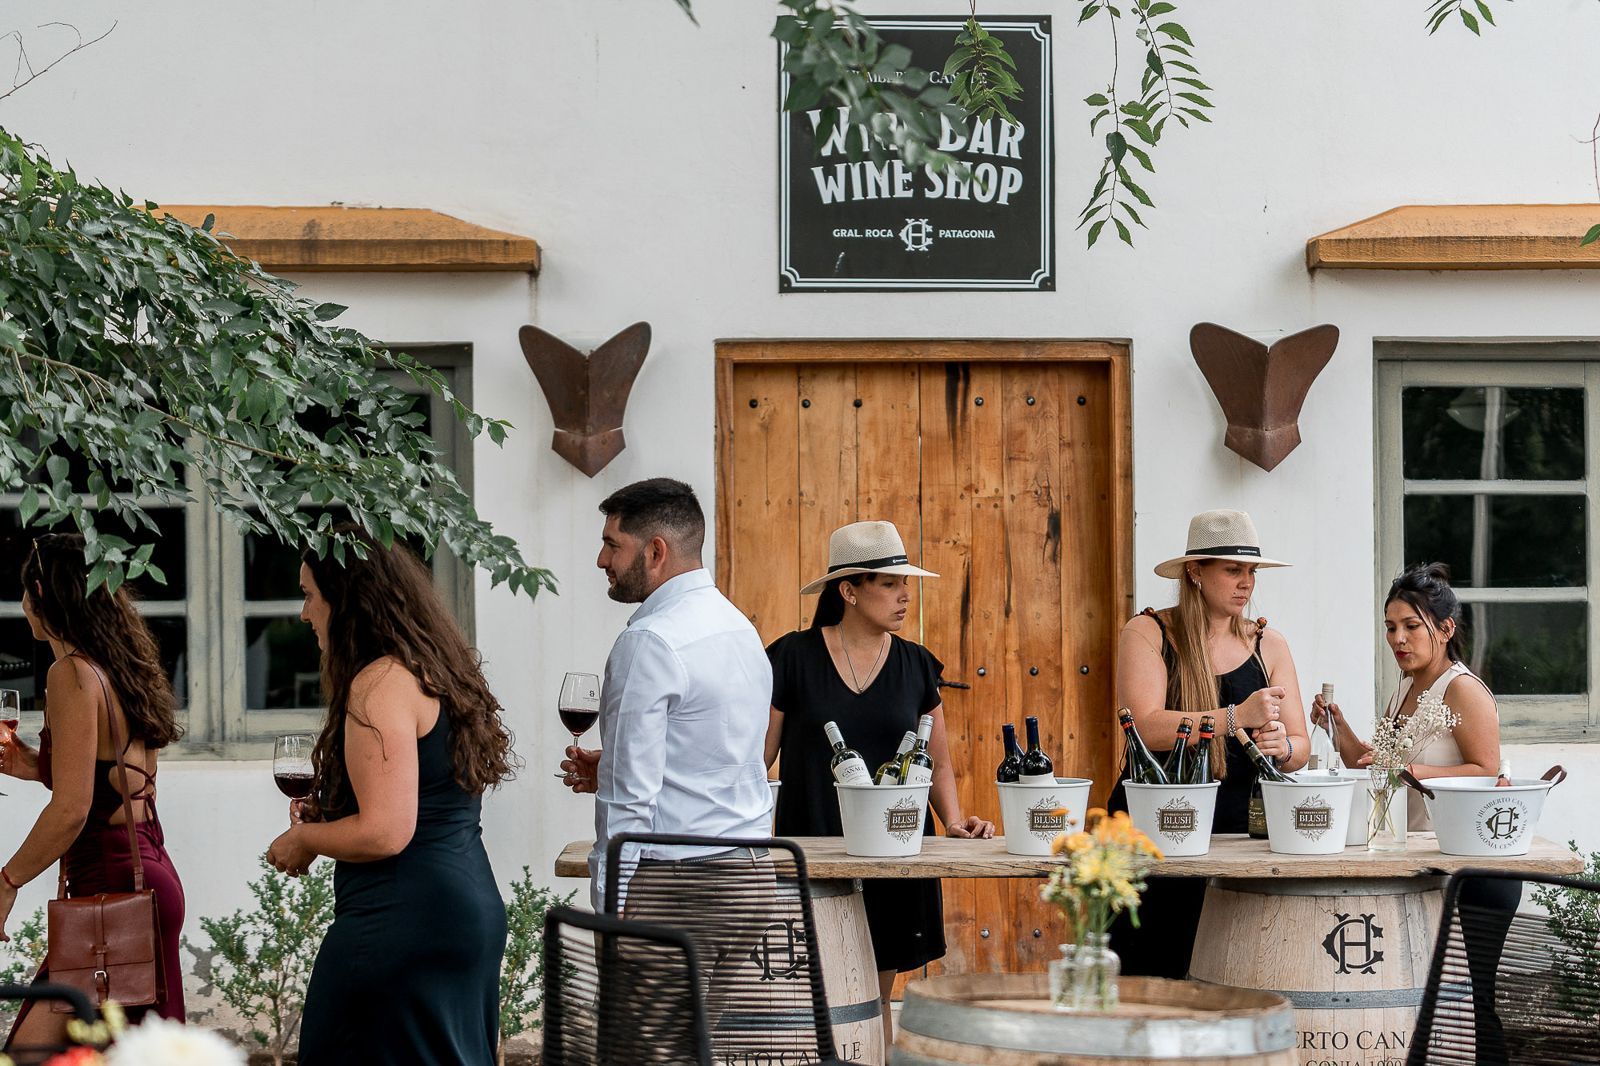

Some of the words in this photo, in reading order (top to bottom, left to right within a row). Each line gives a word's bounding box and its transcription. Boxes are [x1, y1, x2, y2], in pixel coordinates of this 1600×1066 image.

[811, 159, 914, 205] WINE
[924, 161, 1024, 206] SHOP
[832, 228, 864, 238] GRAL.
[865, 228, 894, 238] ROCA
[938, 229, 996, 239] PATAGONIA
[892, 815, 917, 824] BLUSH
[1034, 815, 1062, 824] BLUSH
[1163, 816, 1191, 825] BLUSH
[1299, 814, 1327, 822] BLUSH
